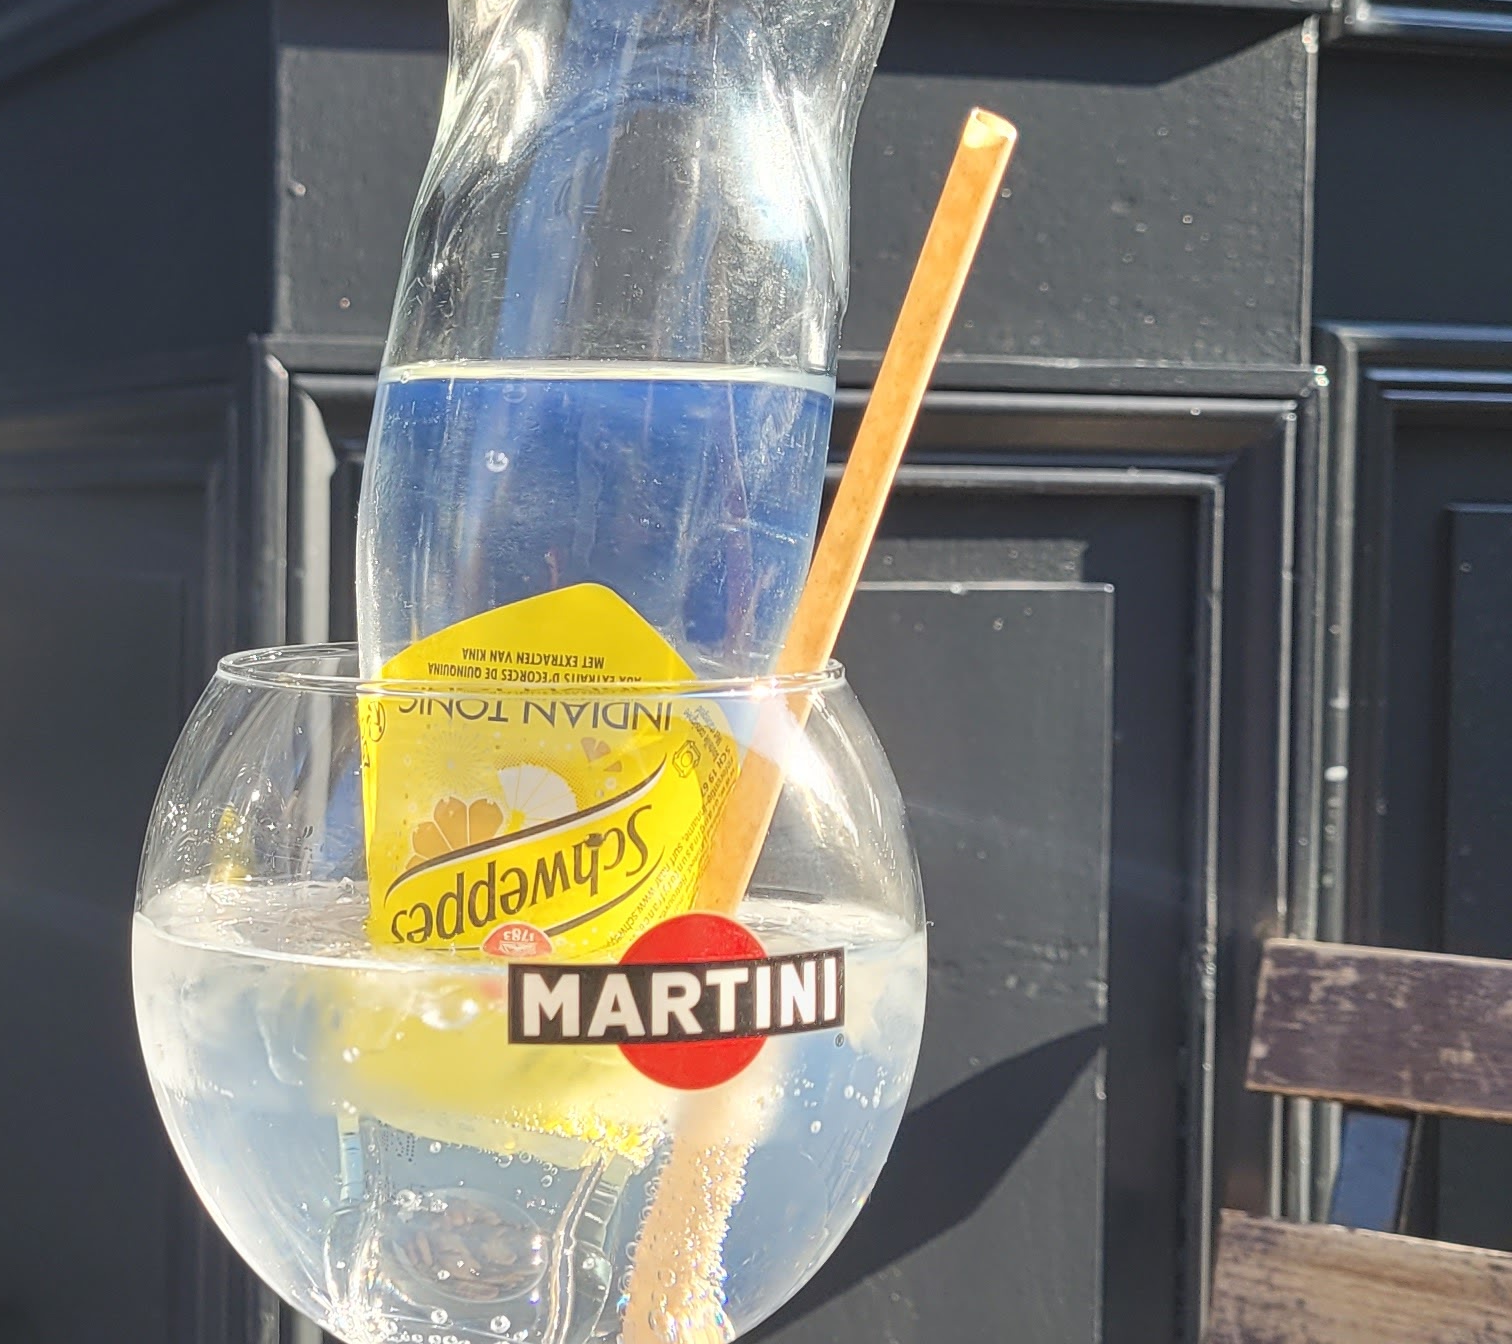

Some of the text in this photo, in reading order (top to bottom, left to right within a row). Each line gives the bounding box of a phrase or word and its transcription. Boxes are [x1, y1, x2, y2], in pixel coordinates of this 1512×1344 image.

[461, 646, 604, 669] MET EXTRACTEN VAN KINA
[427, 662, 480, 678] QUINQUINA
[484, 667, 497, 679] DE
[397, 697, 508, 722] TONIC
[522, 700, 672, 732] INDIAN
[389, 804, 651, 944] Schweppes
[503, 927, 535, 942] 1783
[523, 954, 837, 1036] MARTINI
